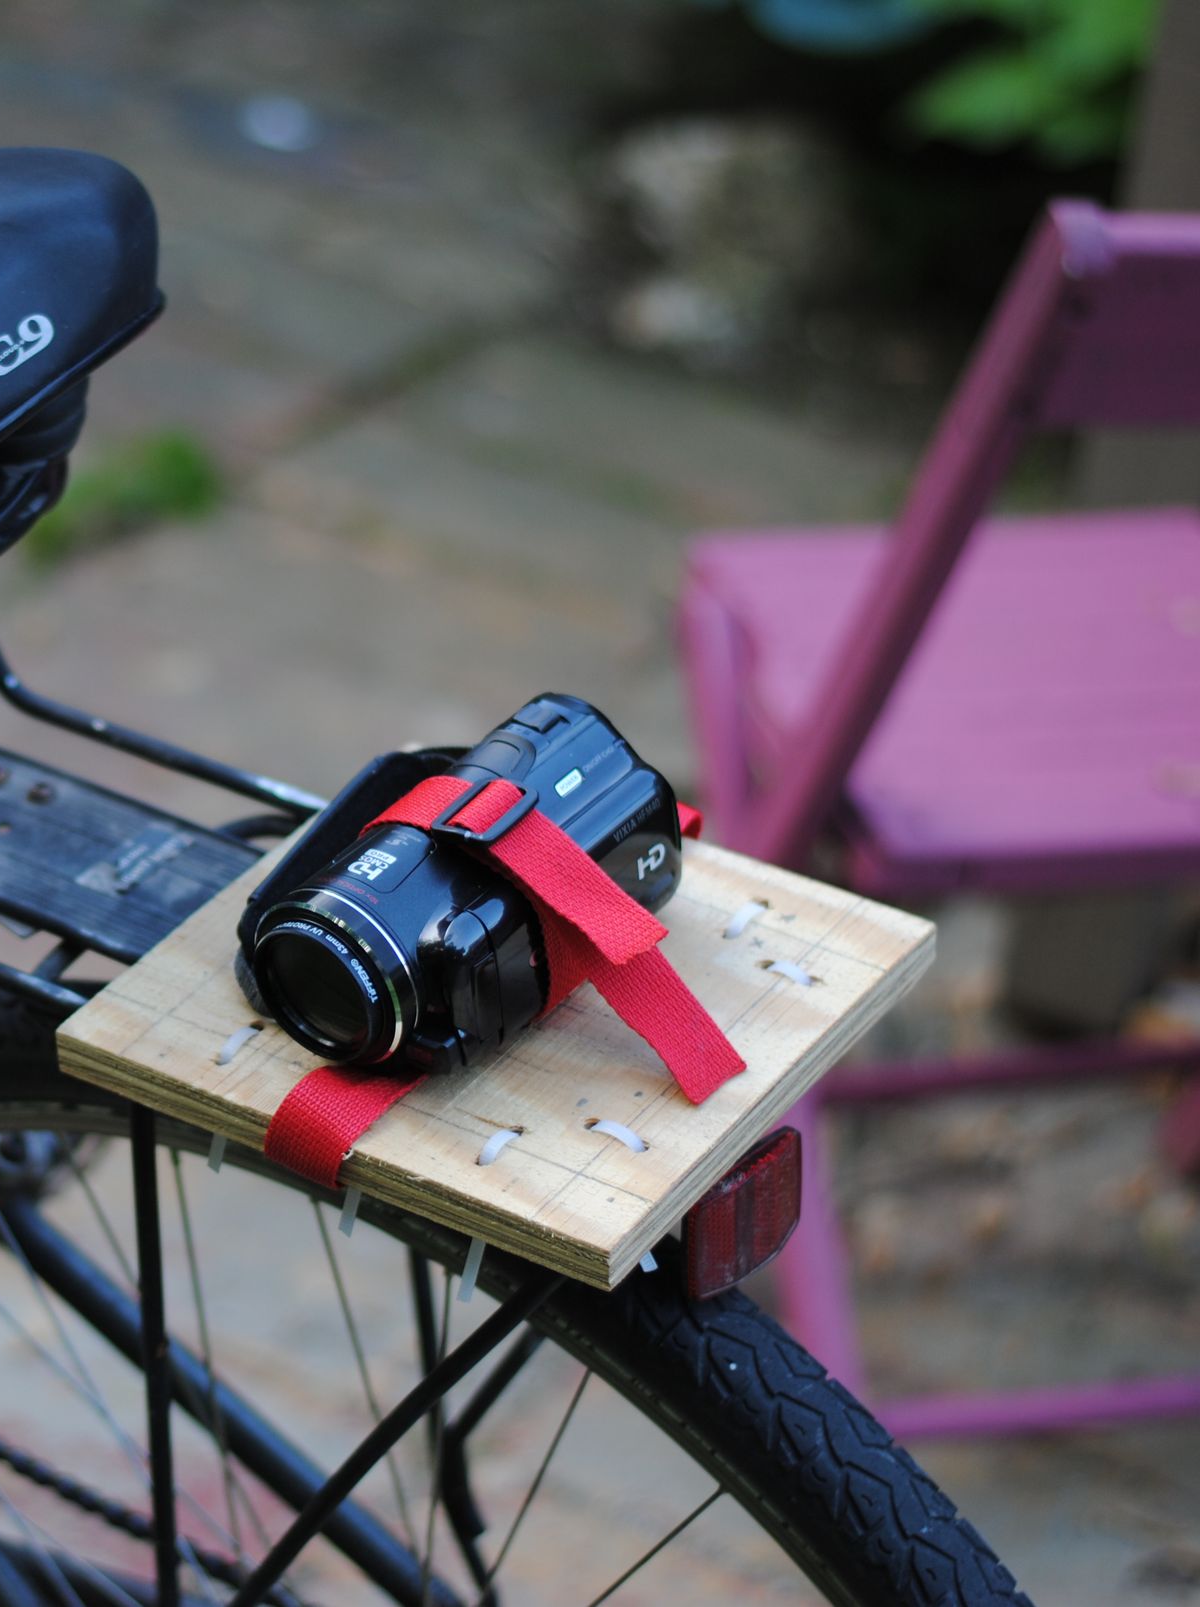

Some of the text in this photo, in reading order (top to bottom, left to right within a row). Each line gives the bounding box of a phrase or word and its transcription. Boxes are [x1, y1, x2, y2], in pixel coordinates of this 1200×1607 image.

[613, 818, 637, 843] VIXIA
[347, 861, 383, 881] HD
[357, 855, 389, 870] CMOS
[637, 843, 666, 881] HD
[310, 927, 324, 937] UV
[325, 934, 349, 955] 43mm
